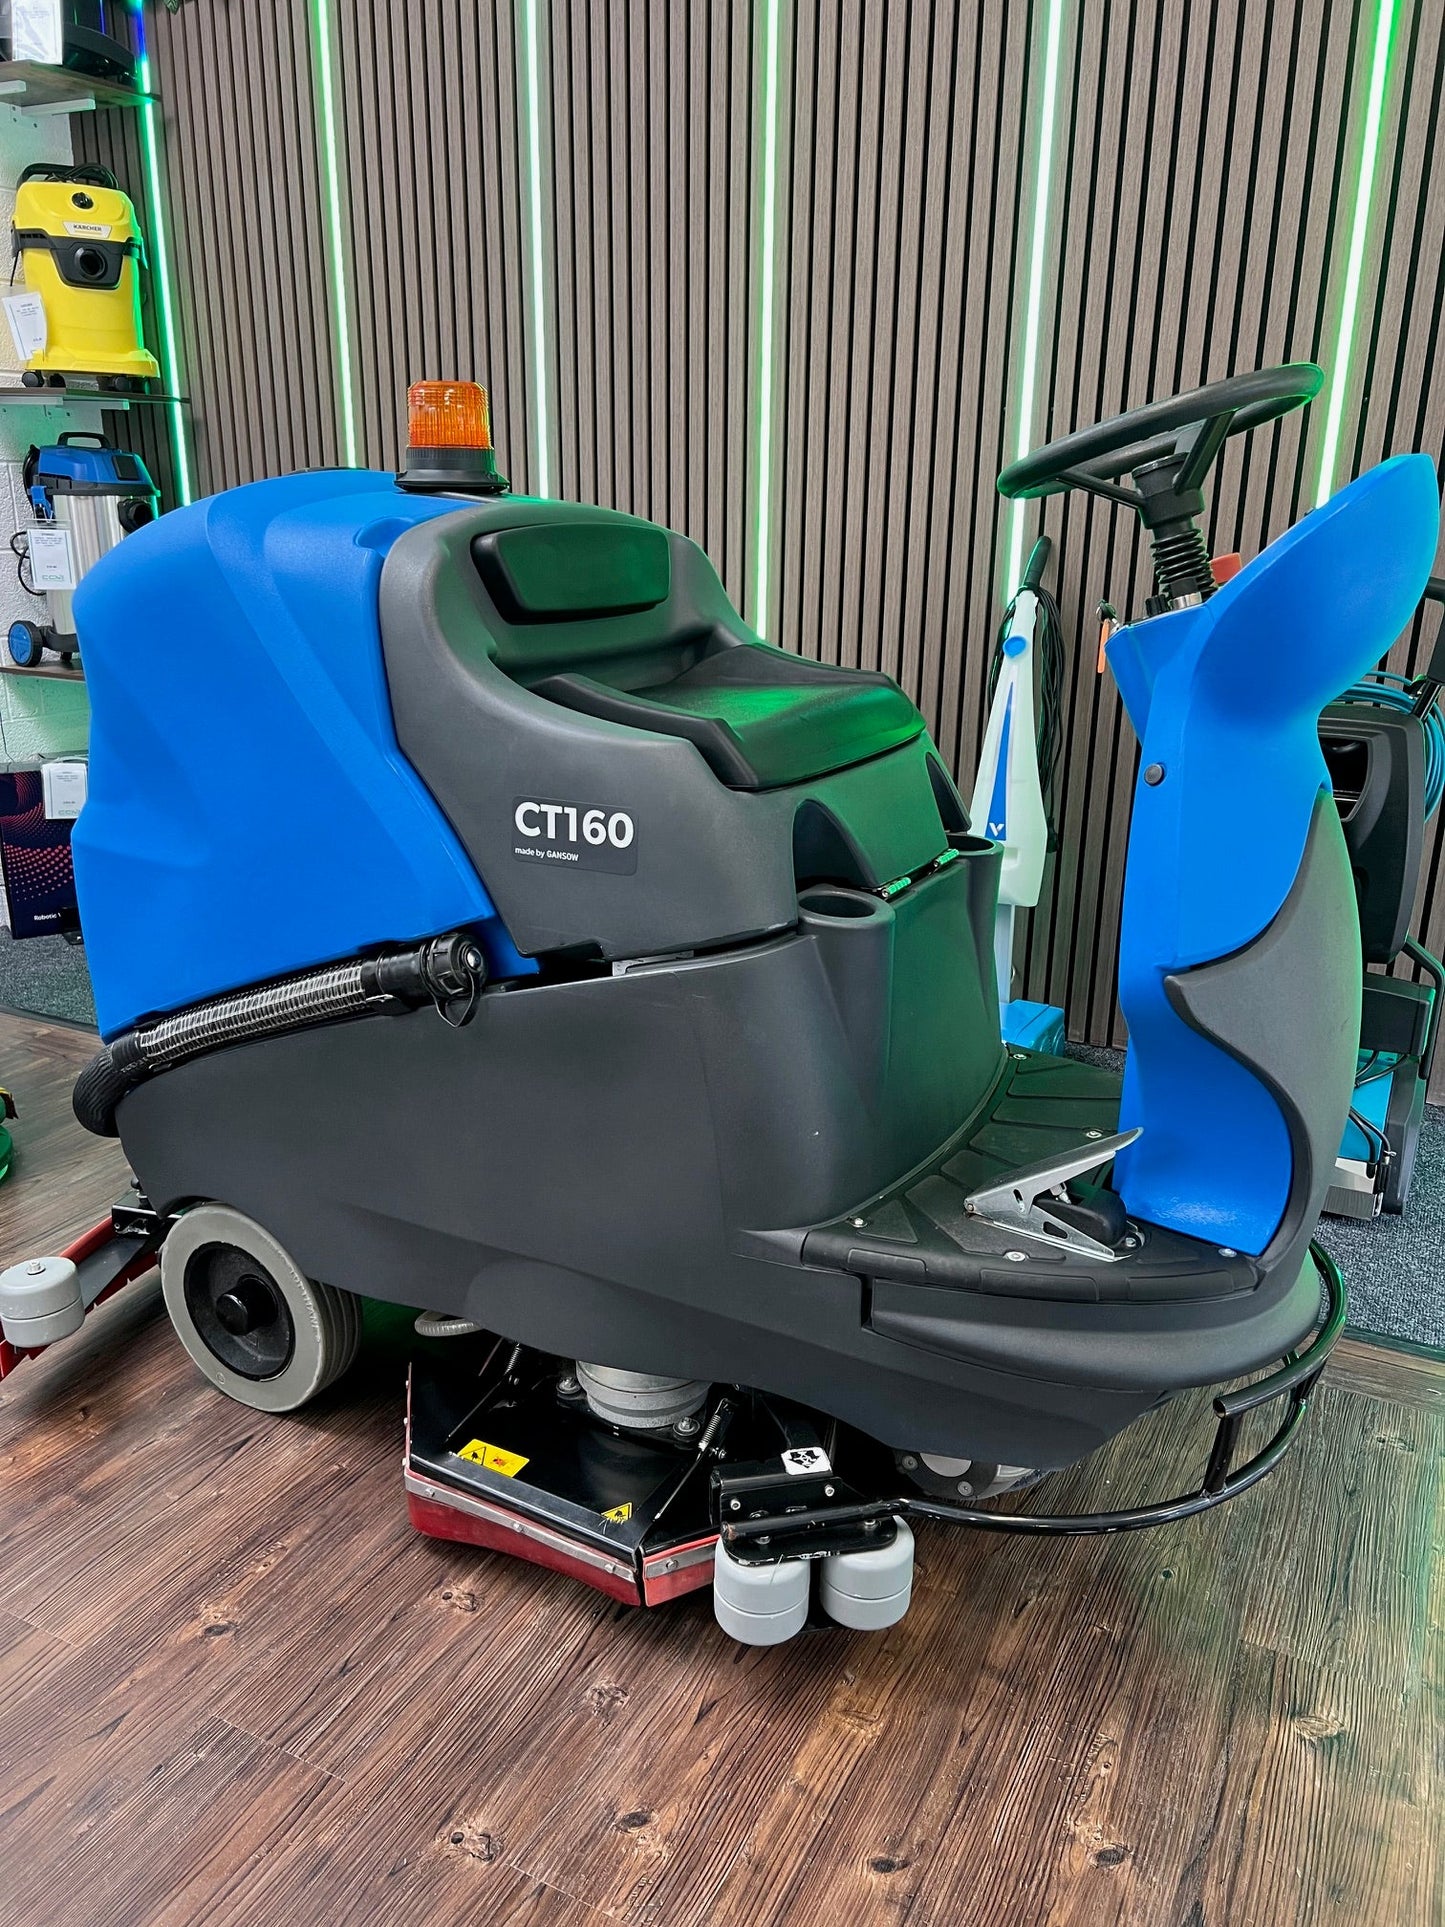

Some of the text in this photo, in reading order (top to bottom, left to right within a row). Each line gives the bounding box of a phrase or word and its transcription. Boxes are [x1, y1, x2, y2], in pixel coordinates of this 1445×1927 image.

[515, 801, 634, 848] CT160
[515, 847, 579, 861] made by GANSOW
